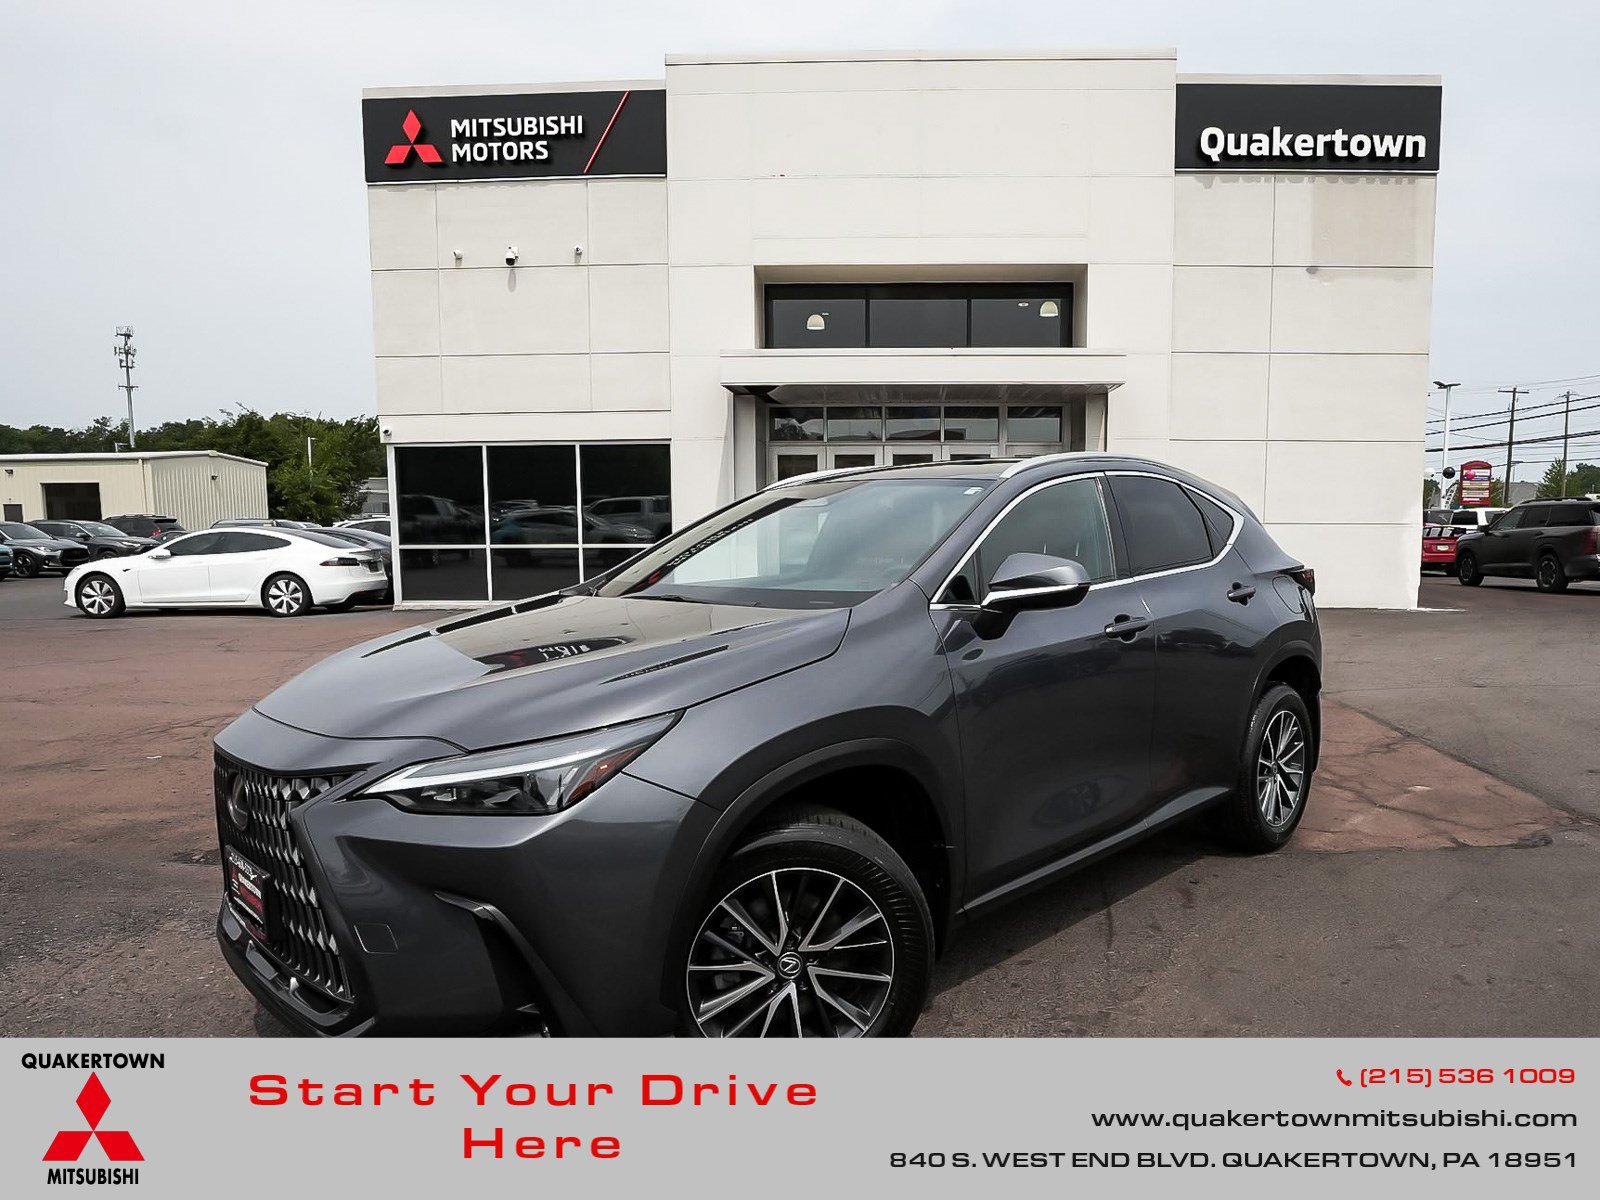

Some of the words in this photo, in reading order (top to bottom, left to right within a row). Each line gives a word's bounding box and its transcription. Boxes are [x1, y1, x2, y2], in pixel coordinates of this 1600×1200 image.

[451, 115, 583, 138] MITSUBISHI
[452, 140, 549, 162] MOTORS
[1200, 126, 1427, 162] Quakertown
